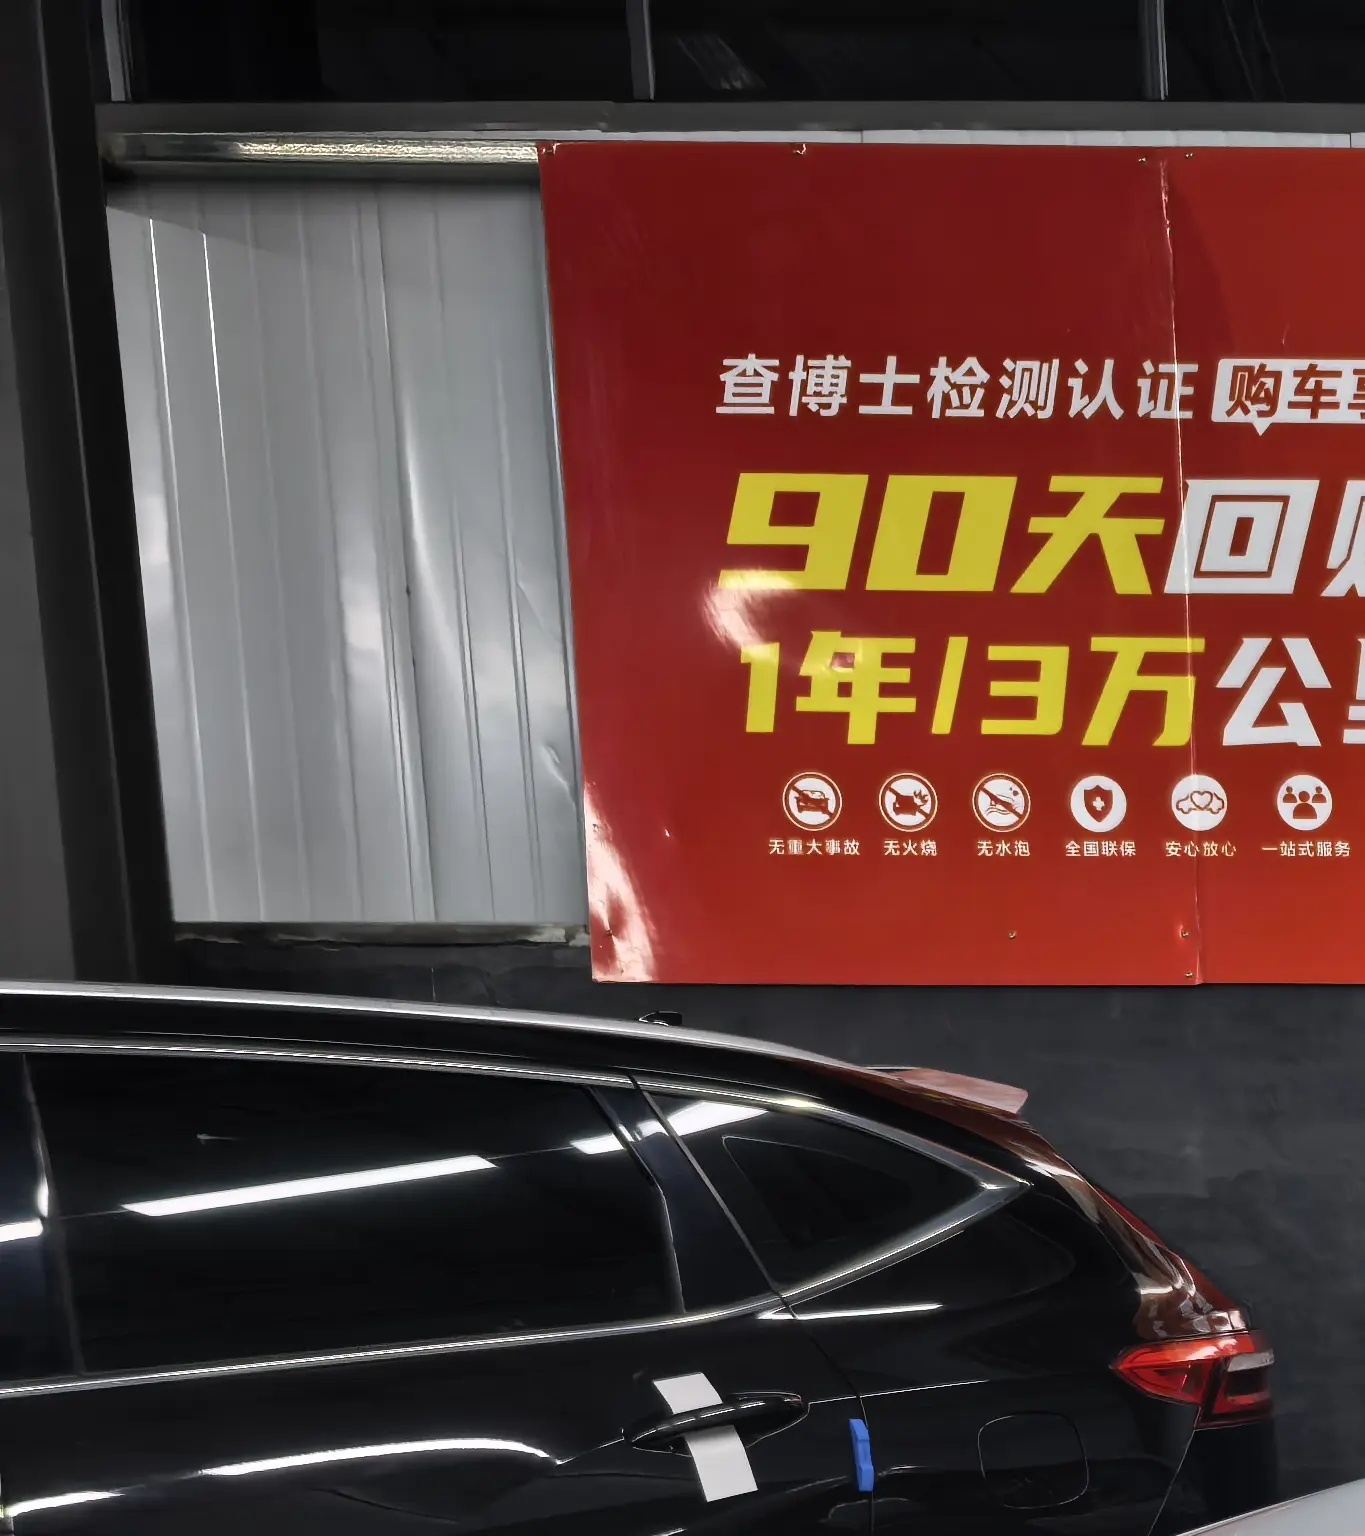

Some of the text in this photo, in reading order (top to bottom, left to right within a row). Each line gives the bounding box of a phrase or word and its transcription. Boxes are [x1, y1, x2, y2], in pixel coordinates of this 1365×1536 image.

[716, 352, 1196, 421] 查博士检测认证
[768, 838, 860, 856] 无重大事故
[884, 839, 937, 857] 无火烧
[977, 840, 1030, 857] 无水泡
[1065, 840, 1137, 857] 全国联保
[1165, 840, 1237, 857] 安心放心
[1261, 840, 1351, 857] 一站式服务
